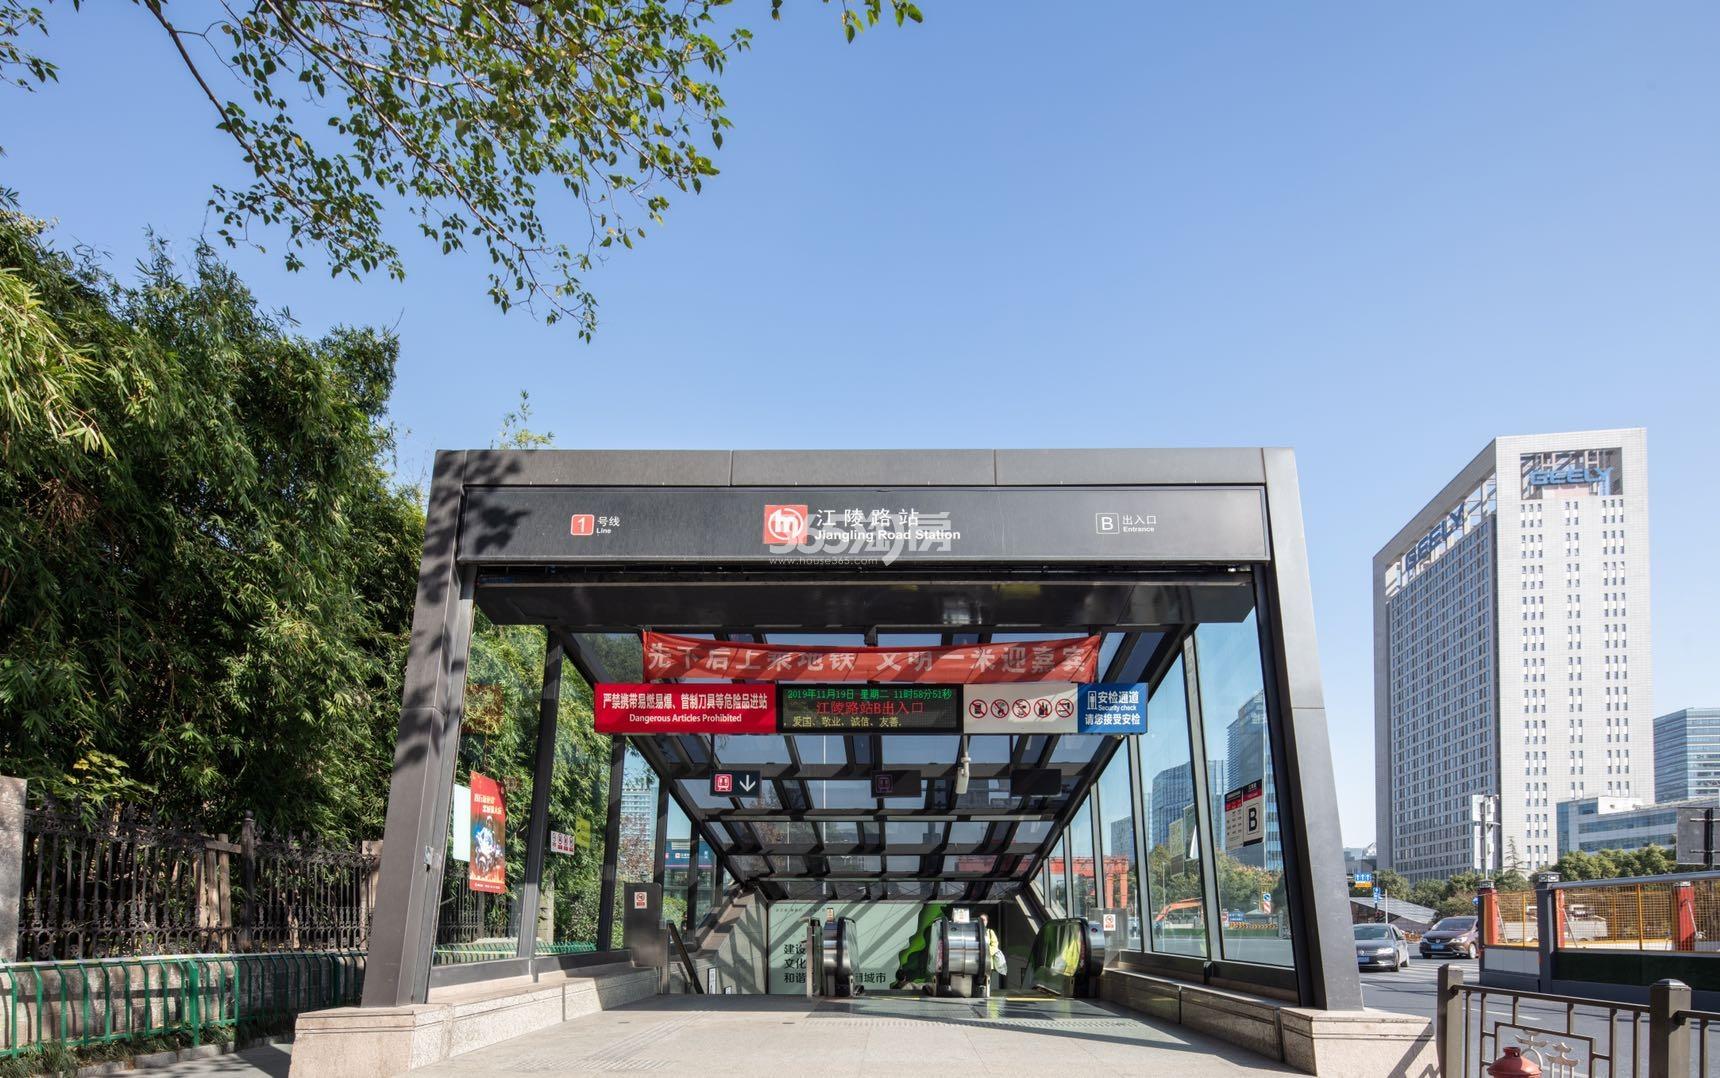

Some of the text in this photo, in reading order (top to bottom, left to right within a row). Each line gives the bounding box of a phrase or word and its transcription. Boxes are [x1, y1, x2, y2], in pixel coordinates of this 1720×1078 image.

[1530, 467, 1612, 488] GEELY
[597, 516, 621, 527] 号线
[816, 507, 919, 527] 江陵路站
[1122, 514, 1157, 525] 出入口
[814, 529, 961, 543] Jiangling Road Station
[1405, 501, 1465, 572] GEELY
[787, 688, 854, 700] 2019年11月19日
[859, 688, 890, 700] 星期二
[1097, 690, 1139, 704] 安检通道
[816, 701, 924, 715] 江陵路站B出入口
[1098, 704, 1119, 712] Security
[629, 713, 742, 724] Dangerous Articles Prohibited
[1085, 713, 1141, 726] 请您接受安检
[1248, 807, 1258, 832] B
